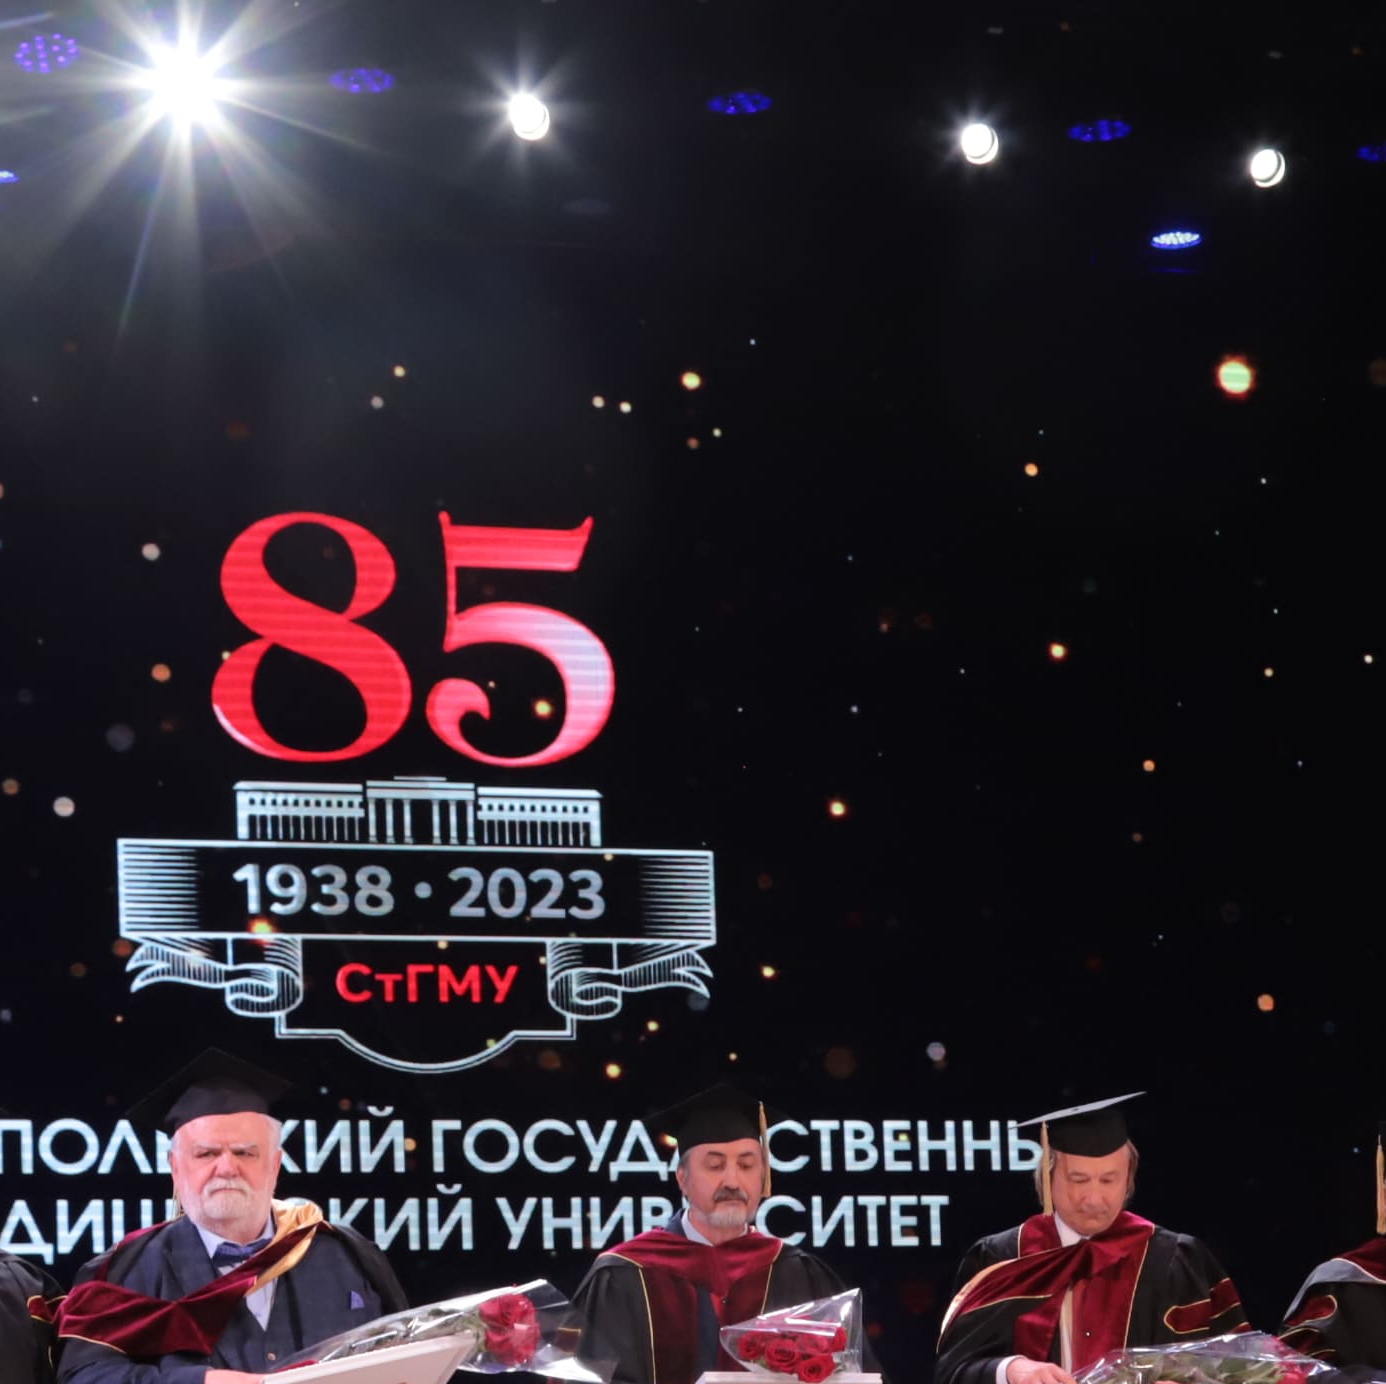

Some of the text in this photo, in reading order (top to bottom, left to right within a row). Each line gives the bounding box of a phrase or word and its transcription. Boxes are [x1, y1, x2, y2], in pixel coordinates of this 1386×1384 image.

[211, 511, 614, 767] 85
[233, 863, 606, 920] 1938 2023
[335, 962, 518, 1004] СтГМУ
[495, 1194, 950, 1250] УНИВСИТЕТ
